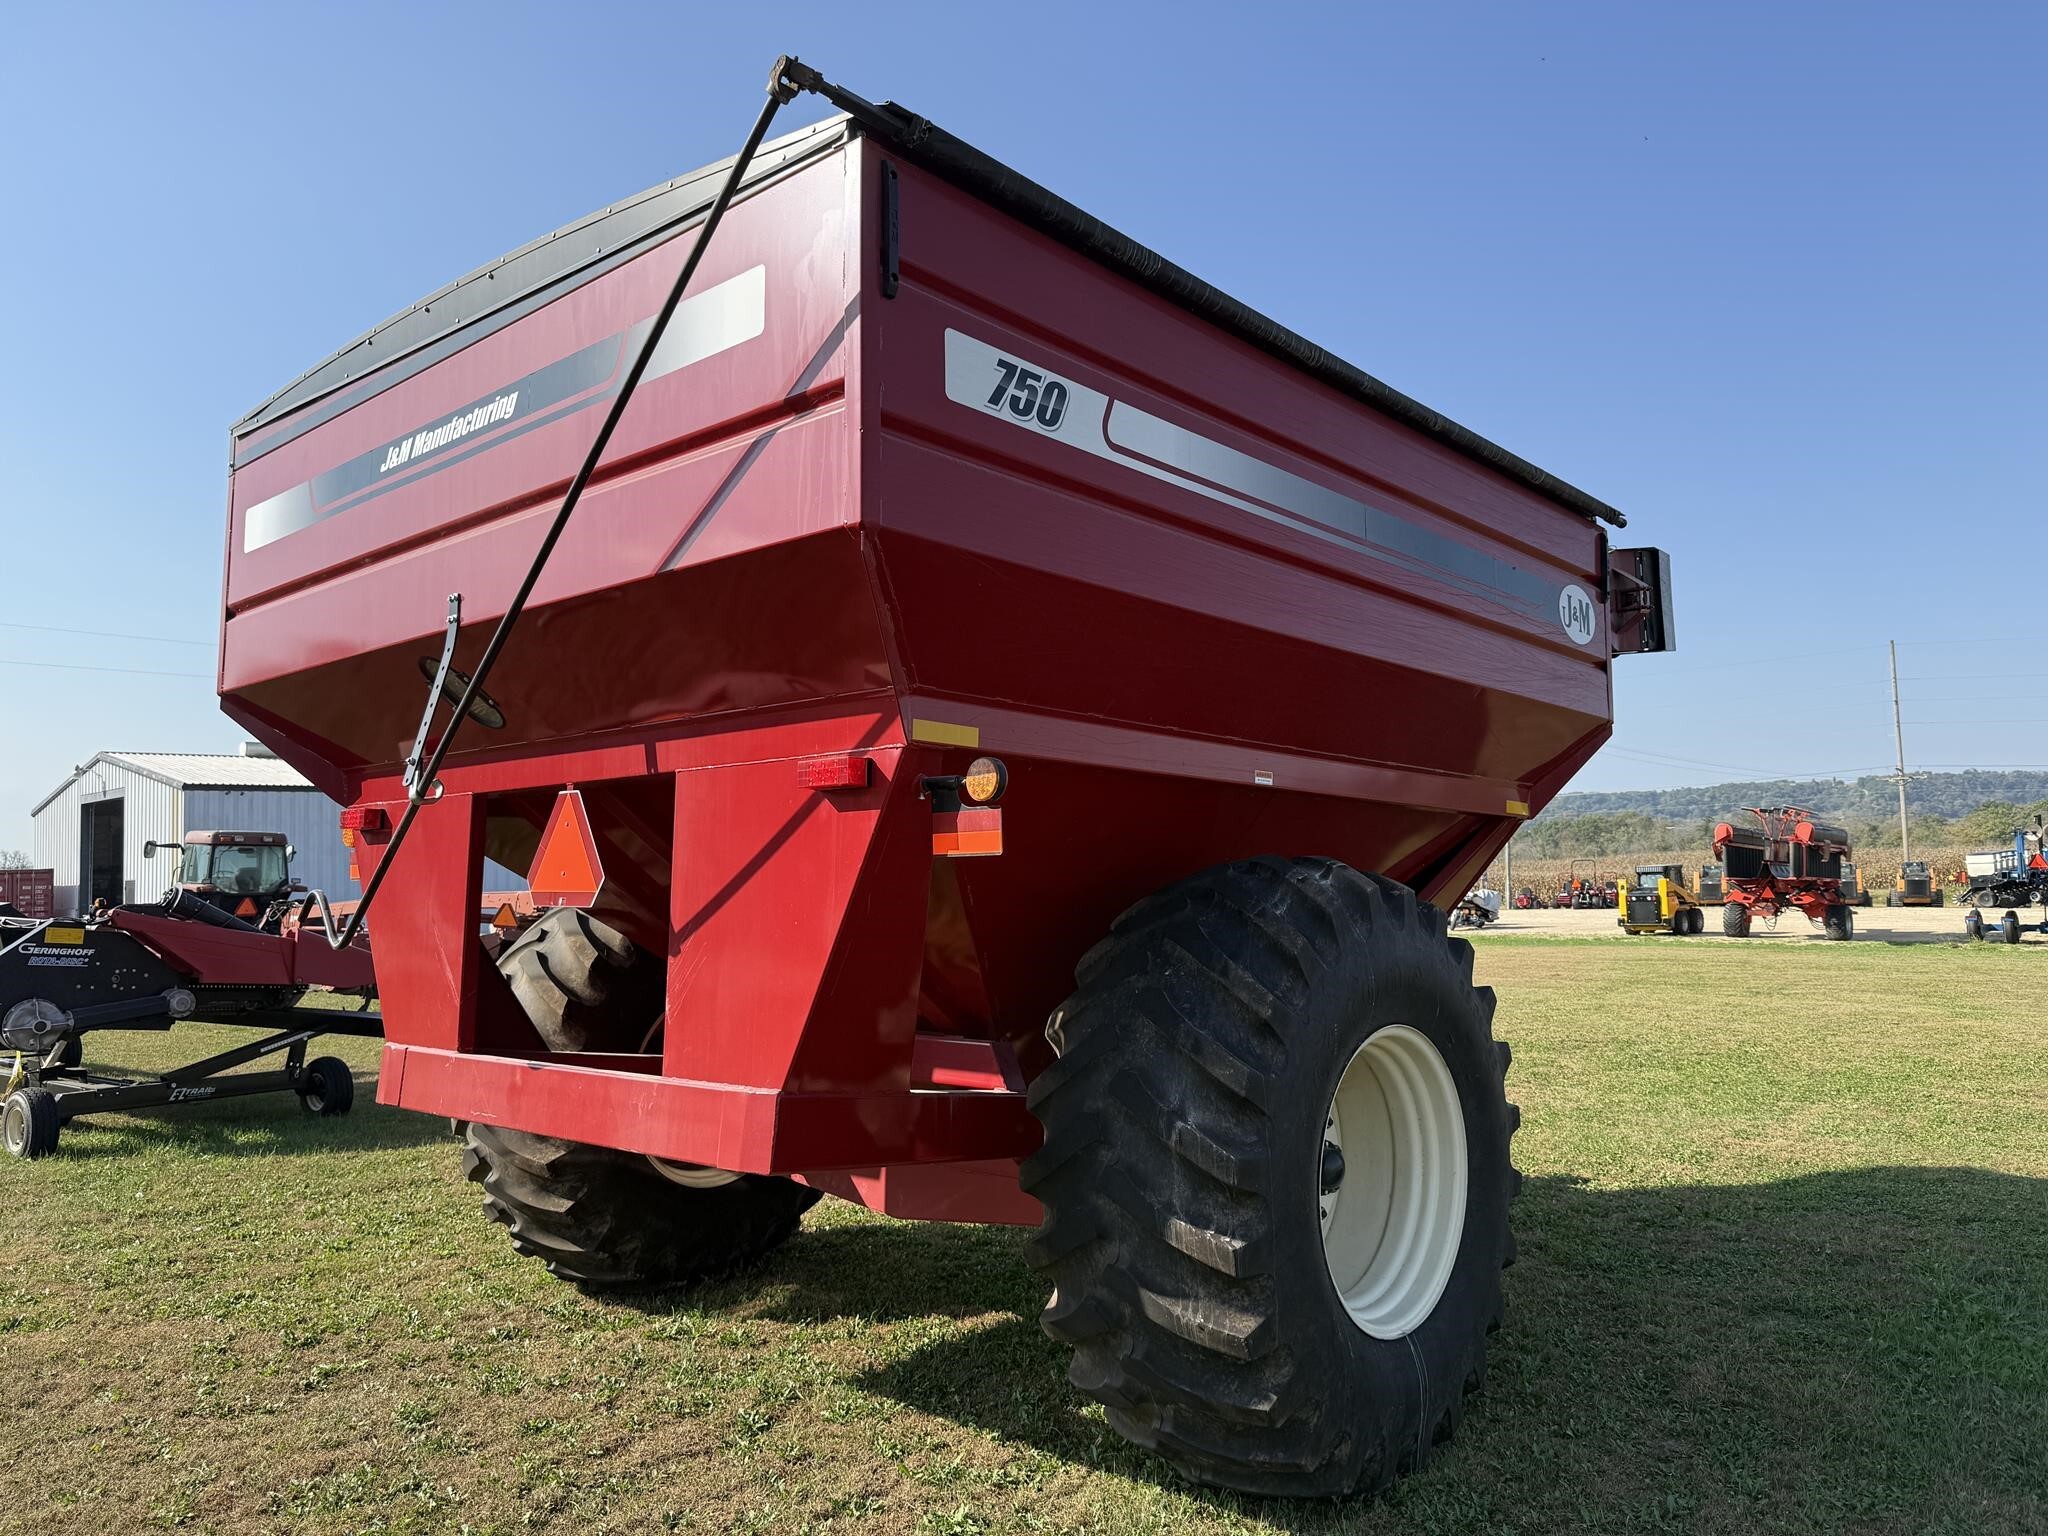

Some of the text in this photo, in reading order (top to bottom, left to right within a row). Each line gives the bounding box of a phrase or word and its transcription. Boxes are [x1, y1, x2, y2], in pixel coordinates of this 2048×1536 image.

[985, 357, 1069, 430] 750
[380, 391, 519, 472] J&M Manufacturing
[1561, 593, 1592, 636] J&M
[18, 942, 96, 956] GERINGHOFF
